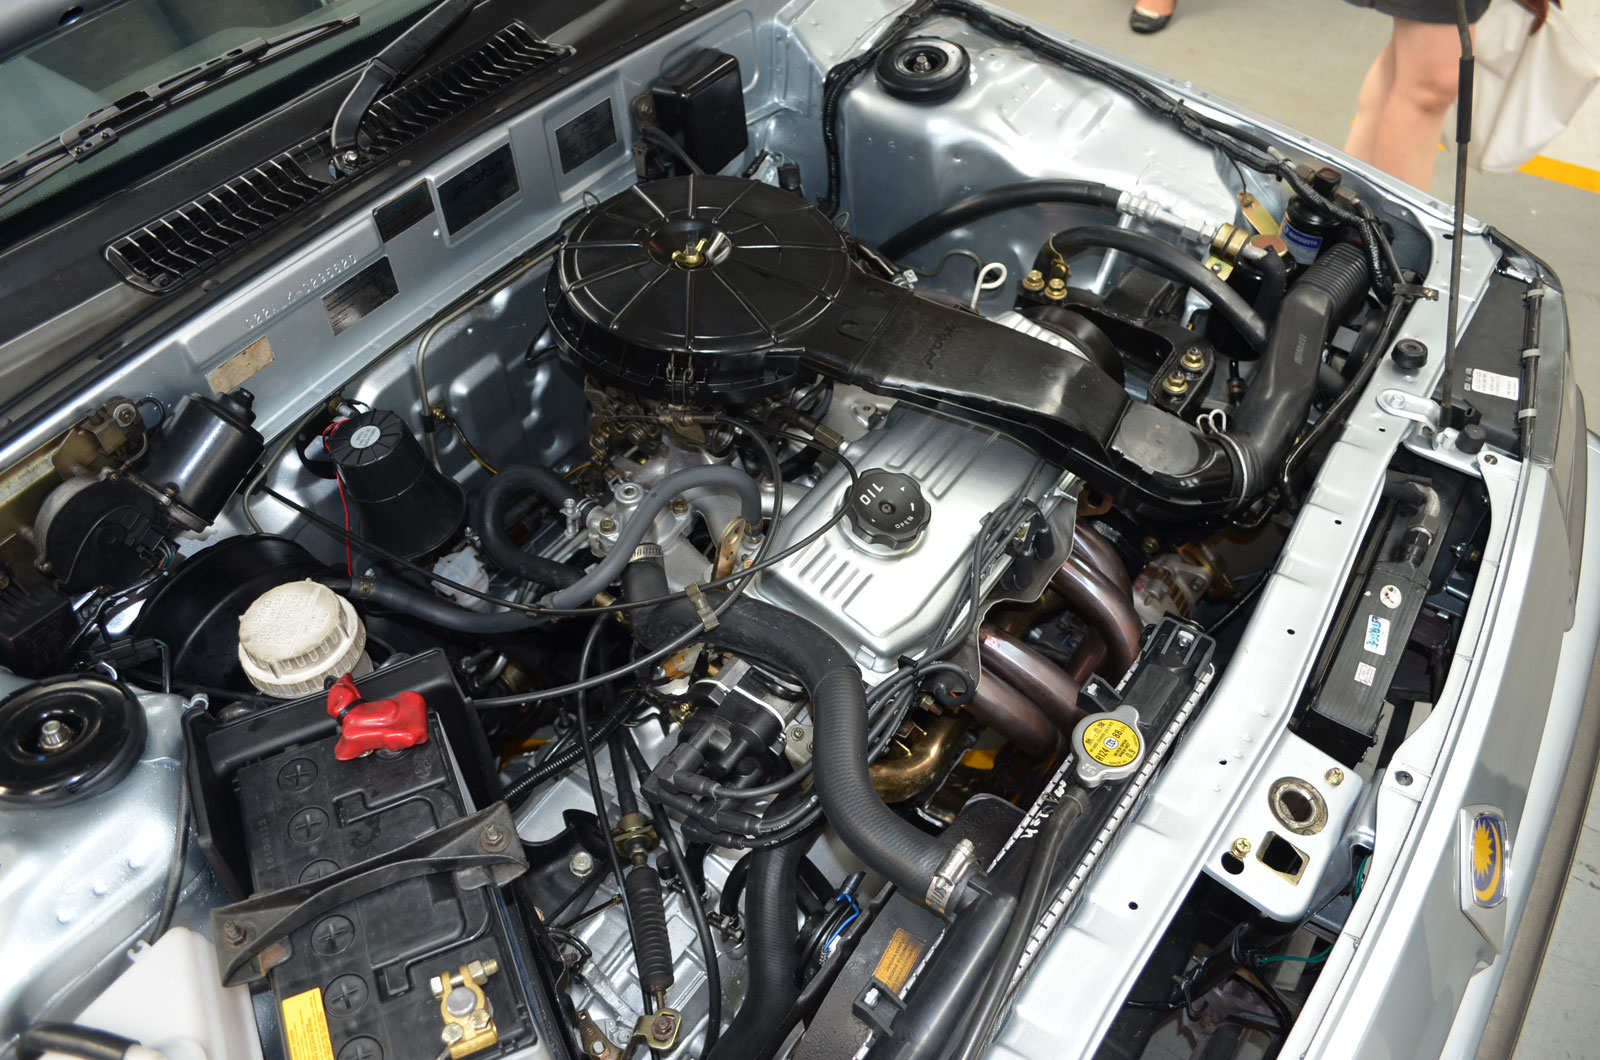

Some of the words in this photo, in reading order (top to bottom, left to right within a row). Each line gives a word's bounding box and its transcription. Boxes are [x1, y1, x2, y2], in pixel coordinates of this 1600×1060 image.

[860, 482, 884, 506] OIL
[895, 516, 914, 529] OPEN
[1095, 747, 1109, 760] R124
[1112, 729, 1122, 738] 88
